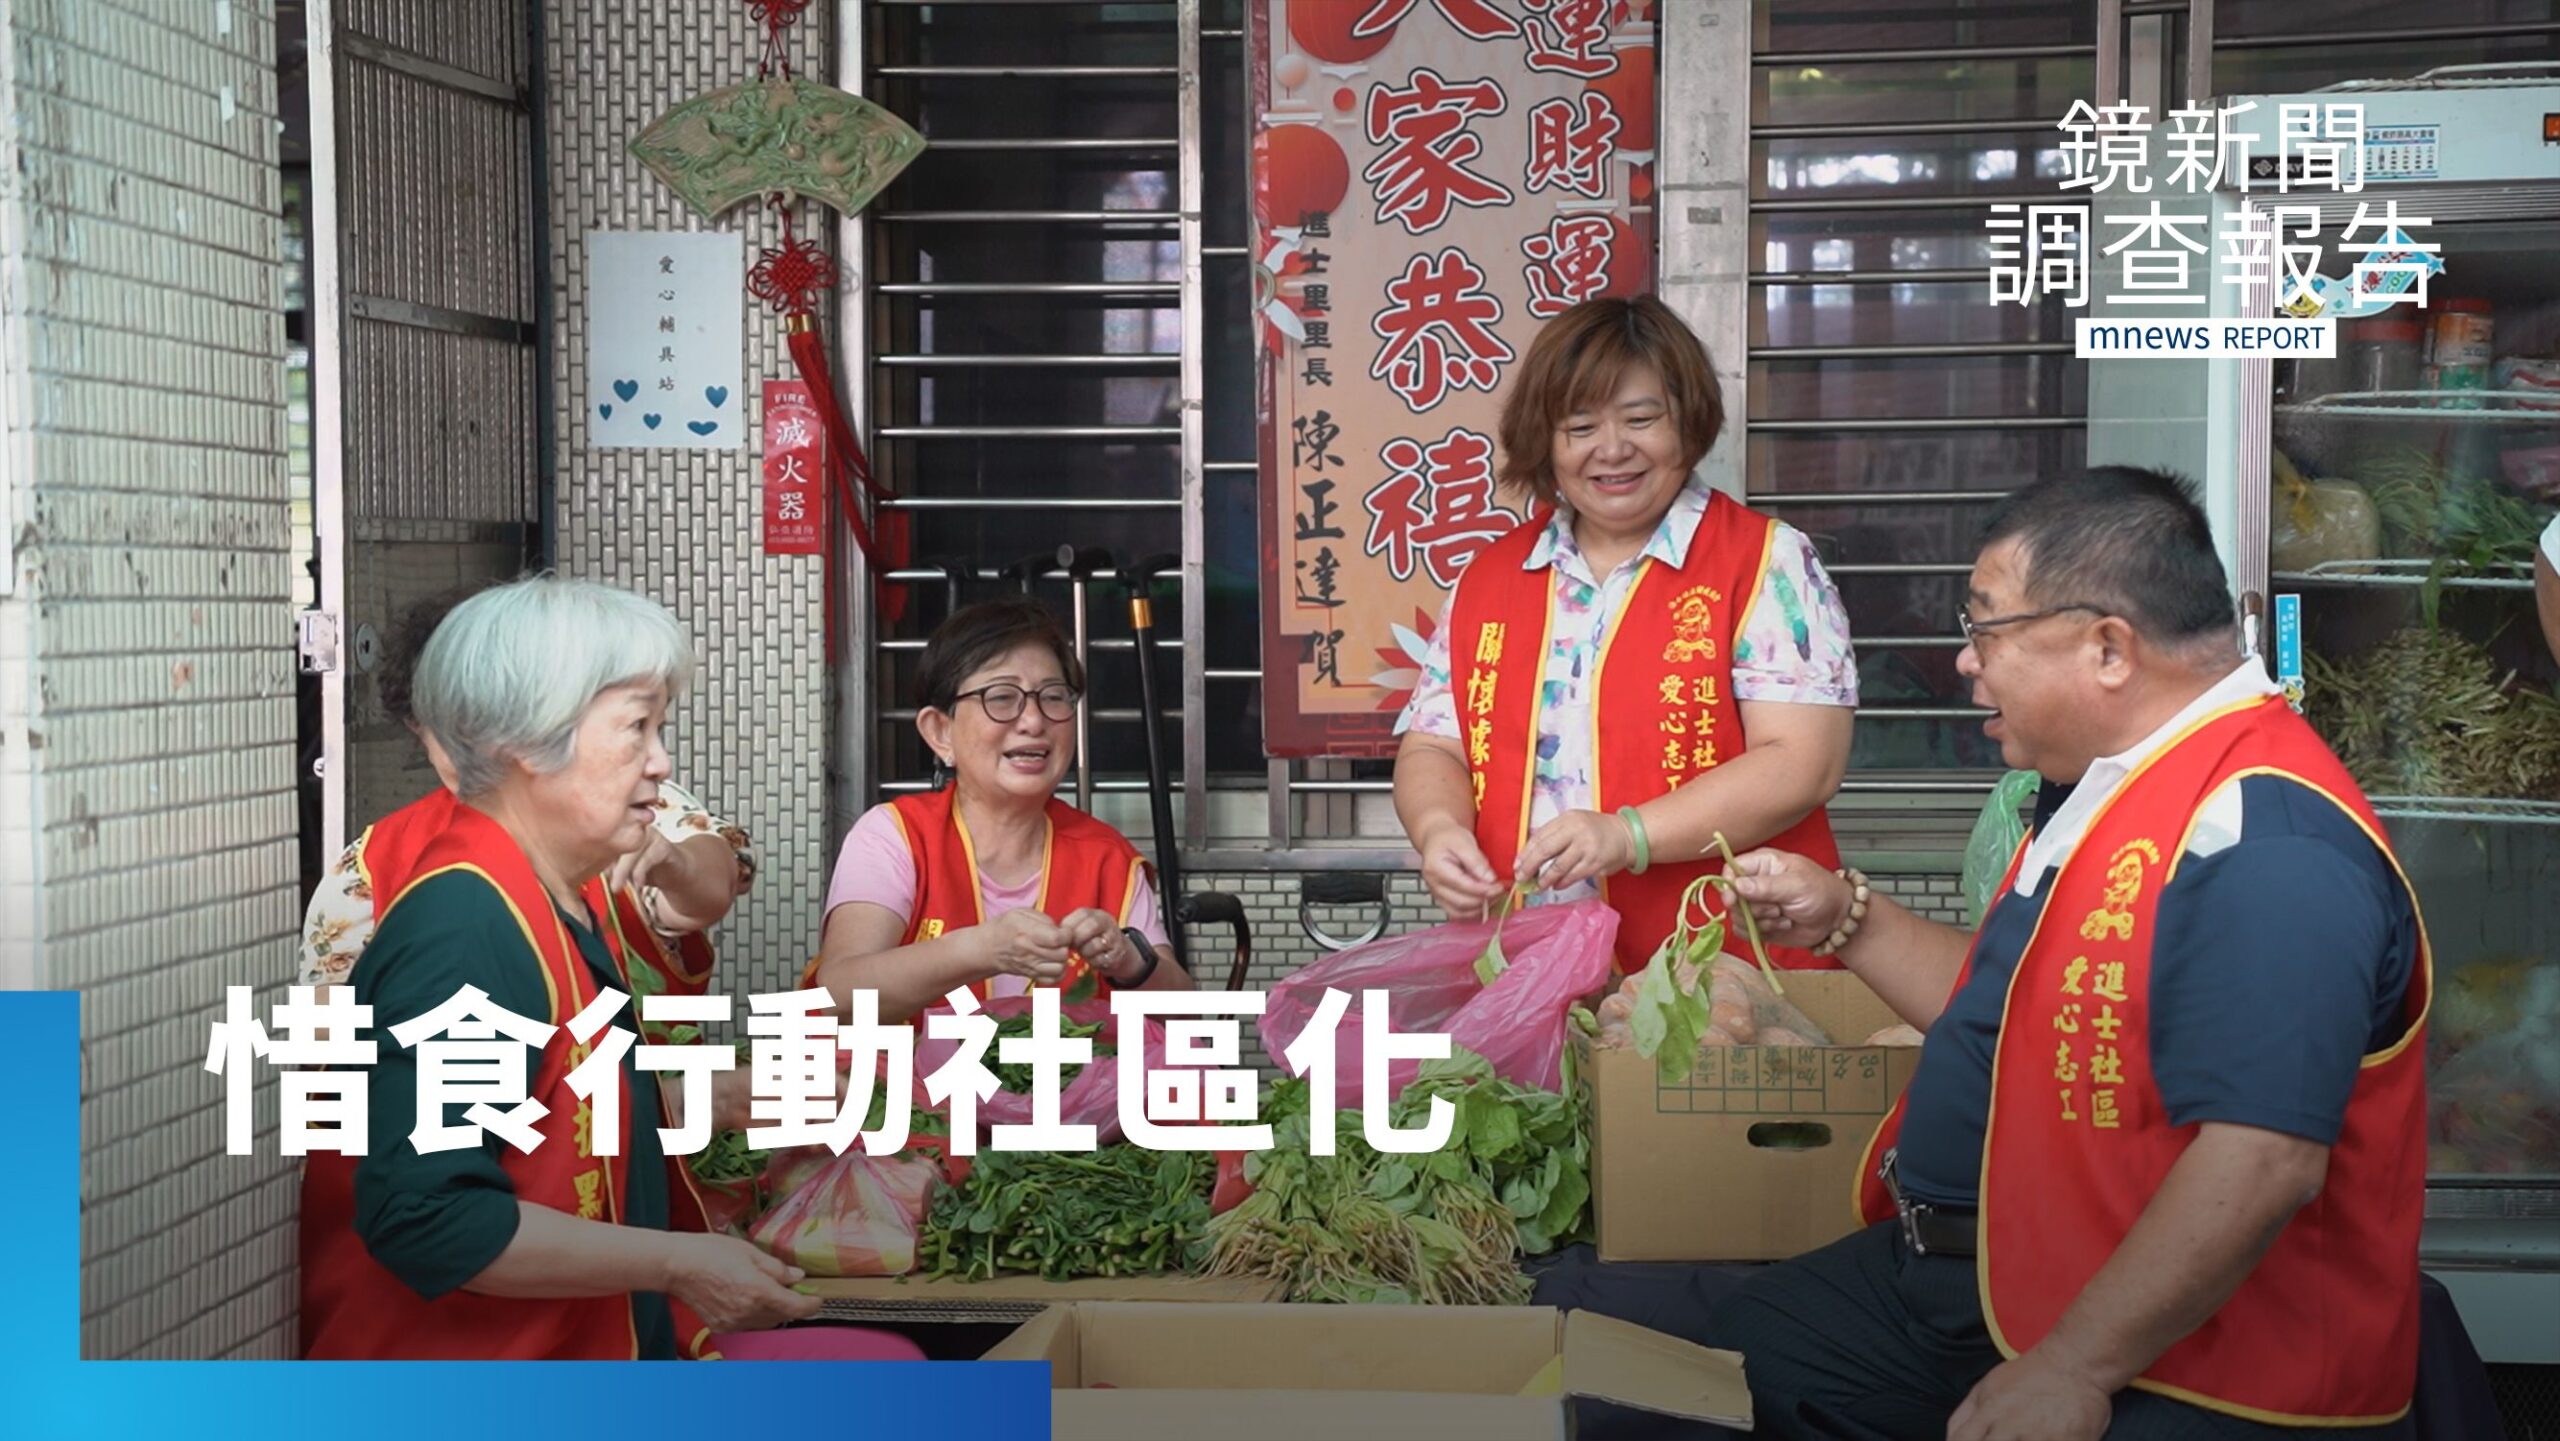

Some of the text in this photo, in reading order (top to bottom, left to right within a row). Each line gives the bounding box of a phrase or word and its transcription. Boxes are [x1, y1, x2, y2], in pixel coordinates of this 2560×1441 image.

[657, 254, 676, 392] 愛心輔具站
[774, 393, 806, 405] FIRE
[776, 416, 811, 520] 滅火器
[2053, 955, 2089, 1120] 愛心志工
[2089, 960, 2128, 1128] 進士社區
